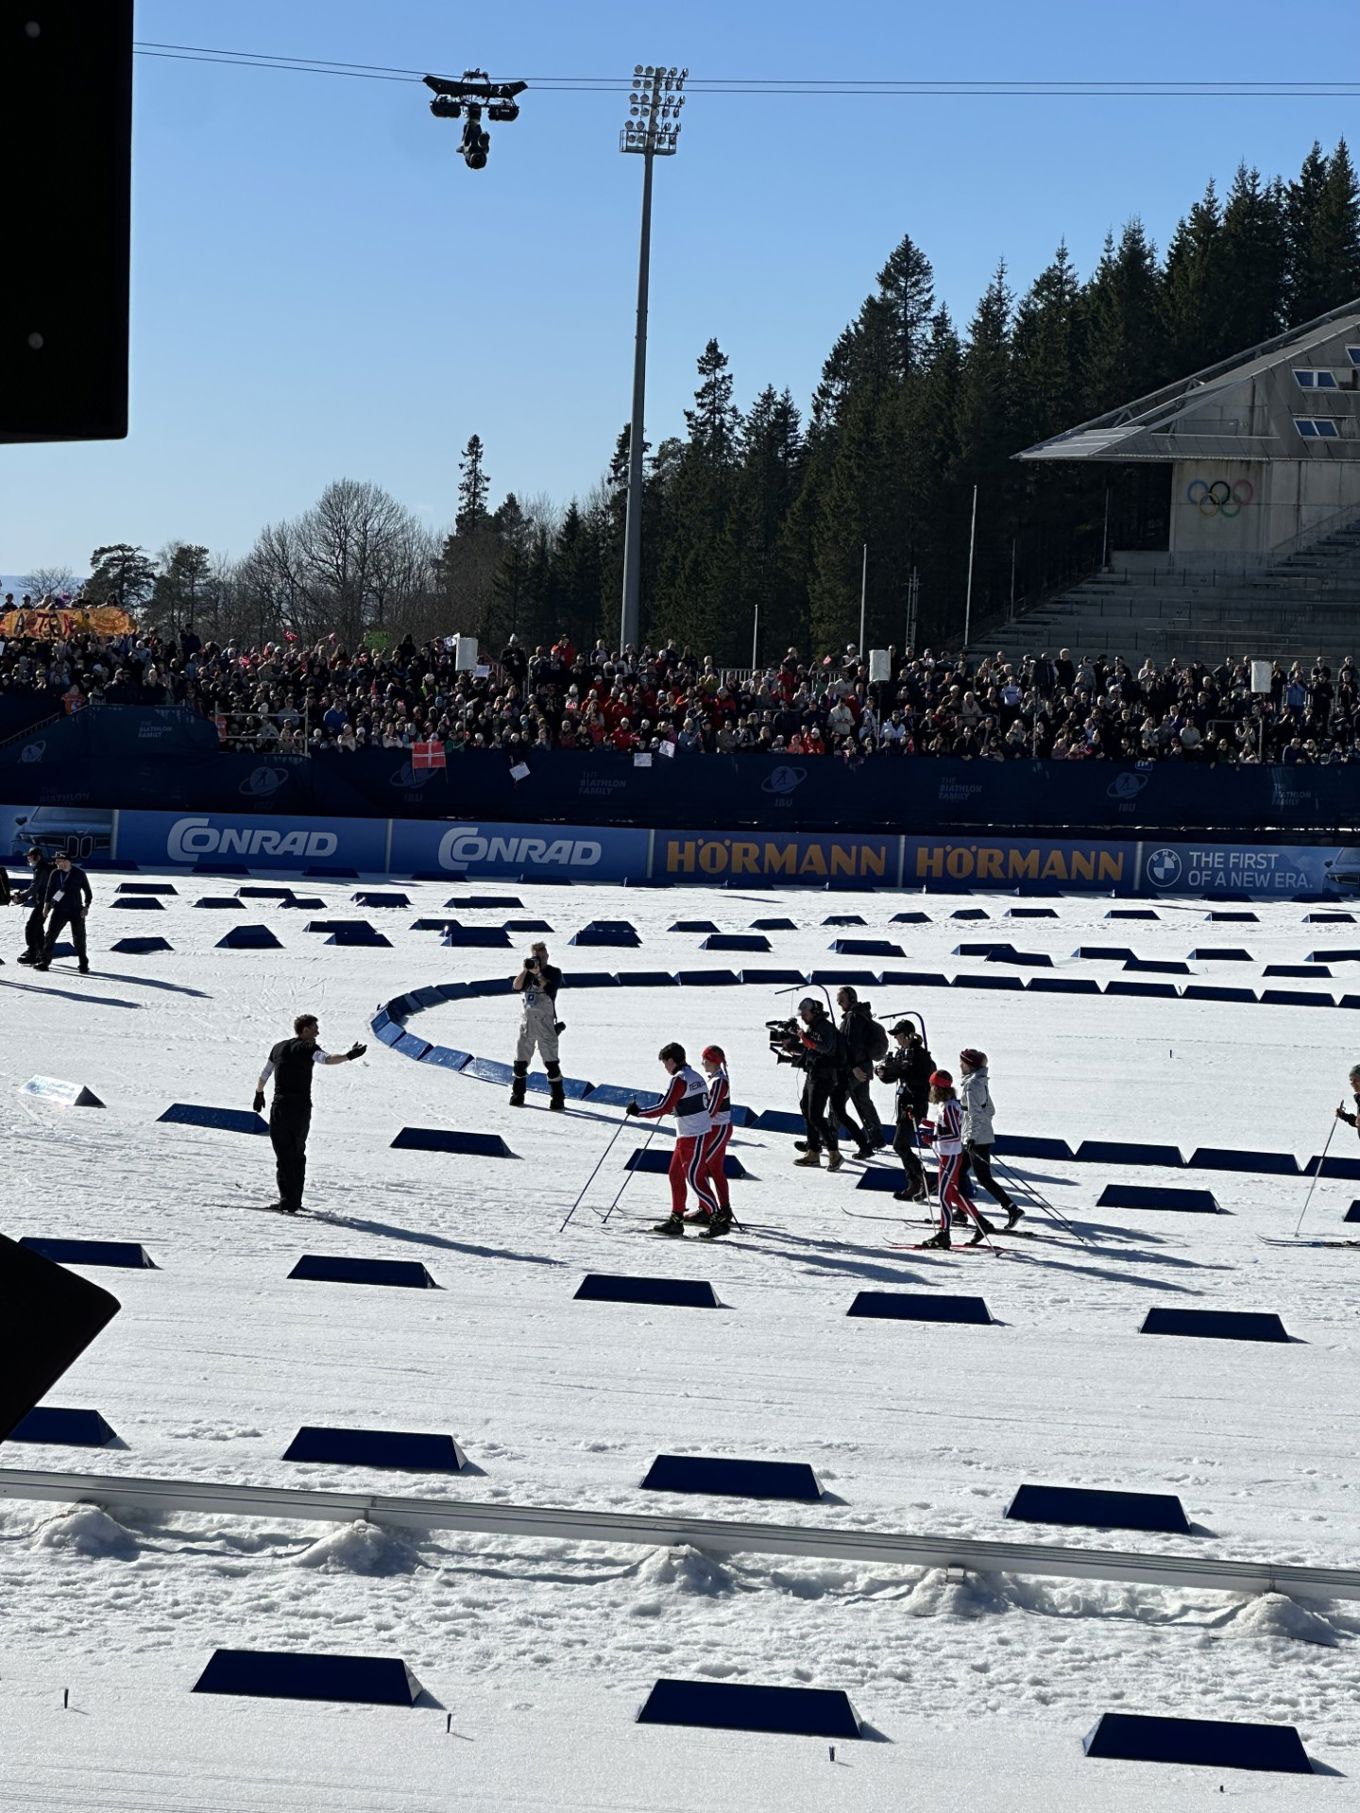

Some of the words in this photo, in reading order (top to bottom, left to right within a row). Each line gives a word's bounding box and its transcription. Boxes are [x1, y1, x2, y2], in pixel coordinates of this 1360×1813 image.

[939, 784, 983, 793] BIATHLON
[774, 798, 793, 808] IBU
[167, 817, 338, 862] CONRAD
[438, 827, 602, 871] CONRAD
[666, 838, 886, 877] HÖRMANN
[916, 845, 1124, 881] HÖRMANN
[1189, 852, 1225, 868] THE
[1229, 853, 1280, 870] FIRST
[1188, 871, 1212, 886] OF
[1214, 872, 1228, 887] A
[1230, 872, 1272, 888] NEW
[1275, 873, 1314, 889] ERA.
